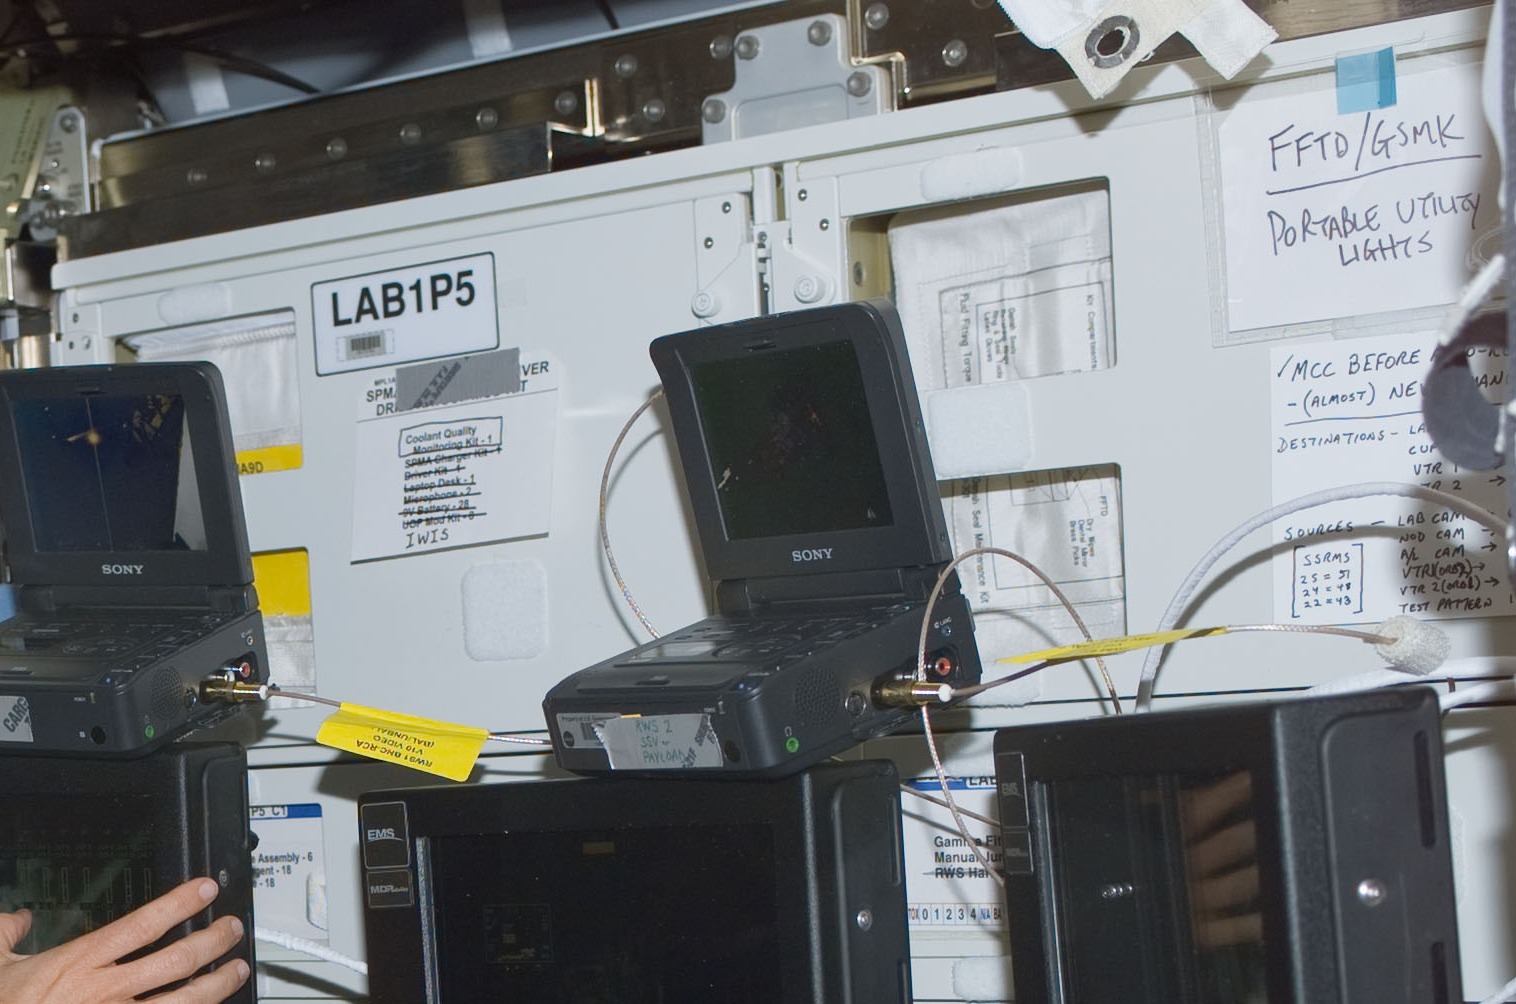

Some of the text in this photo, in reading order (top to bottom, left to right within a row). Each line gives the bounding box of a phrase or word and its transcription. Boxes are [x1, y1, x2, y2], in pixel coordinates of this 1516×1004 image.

[1267, 192, 1481, 256] PORTABLE UTILITY
[1338, 230, 1433, 266] LIGHTS
[331, 269, 476, 327] LAB1P5
[962, 351, 973, 383] Torque
[1291, 349, 1421, 383] MCC BEFORE
[366, 386, 397, 403] SPM
[1303, 381, 1376, 418] (ALMOST)
[405, 425, 477, 444] Coolant Quality
[1277, 428, 1386, 454] DESTINATIONS
[412, 441, 463, 455] Monitoring
[465, 437, 479, 448] Kit
[404, 448, 488, 469] SPMA Charger Kit
[403, 469, 433, 481] Driver
[1413, 461, 1443, 476] VTR
[403, 481, 435, 493] Laptop
[438, 476, 462, 487] Desk
[403, 491, 458, 505] Microphone
[417, 503, 450, 516] Battery
[1283, 509, 1467, 541] SOURCES LAB CAM
[1435, 527, 1466, 541] CAM
[792, 548, 833, 562] SONY
[972, 510, 990, 604] Seal Kit
[1434, 543, 1466, 558] CAM
[1303, 551, 1351, 567] SSRMS
[101, 564, 144, 575] SONY
[1399, 584, 1426, 596] VTR
[1398, 597, 1493, 614] TEST PATTERN
[635, 719, 673, 733] RWS 2
[372, 734, 404, 749] VIDEO
[367, 828, 395, 840] EMS
[258, 852, 300, 864] Assembly
[281, 865, 292, 876] 18
[935, 866, 965, 879] RWS
[922, 908, 929, 920] 0
[946, 908, 953, 920] 2
[958, 908, 965, 920] 3
[969, 908, 977, 920] 4
